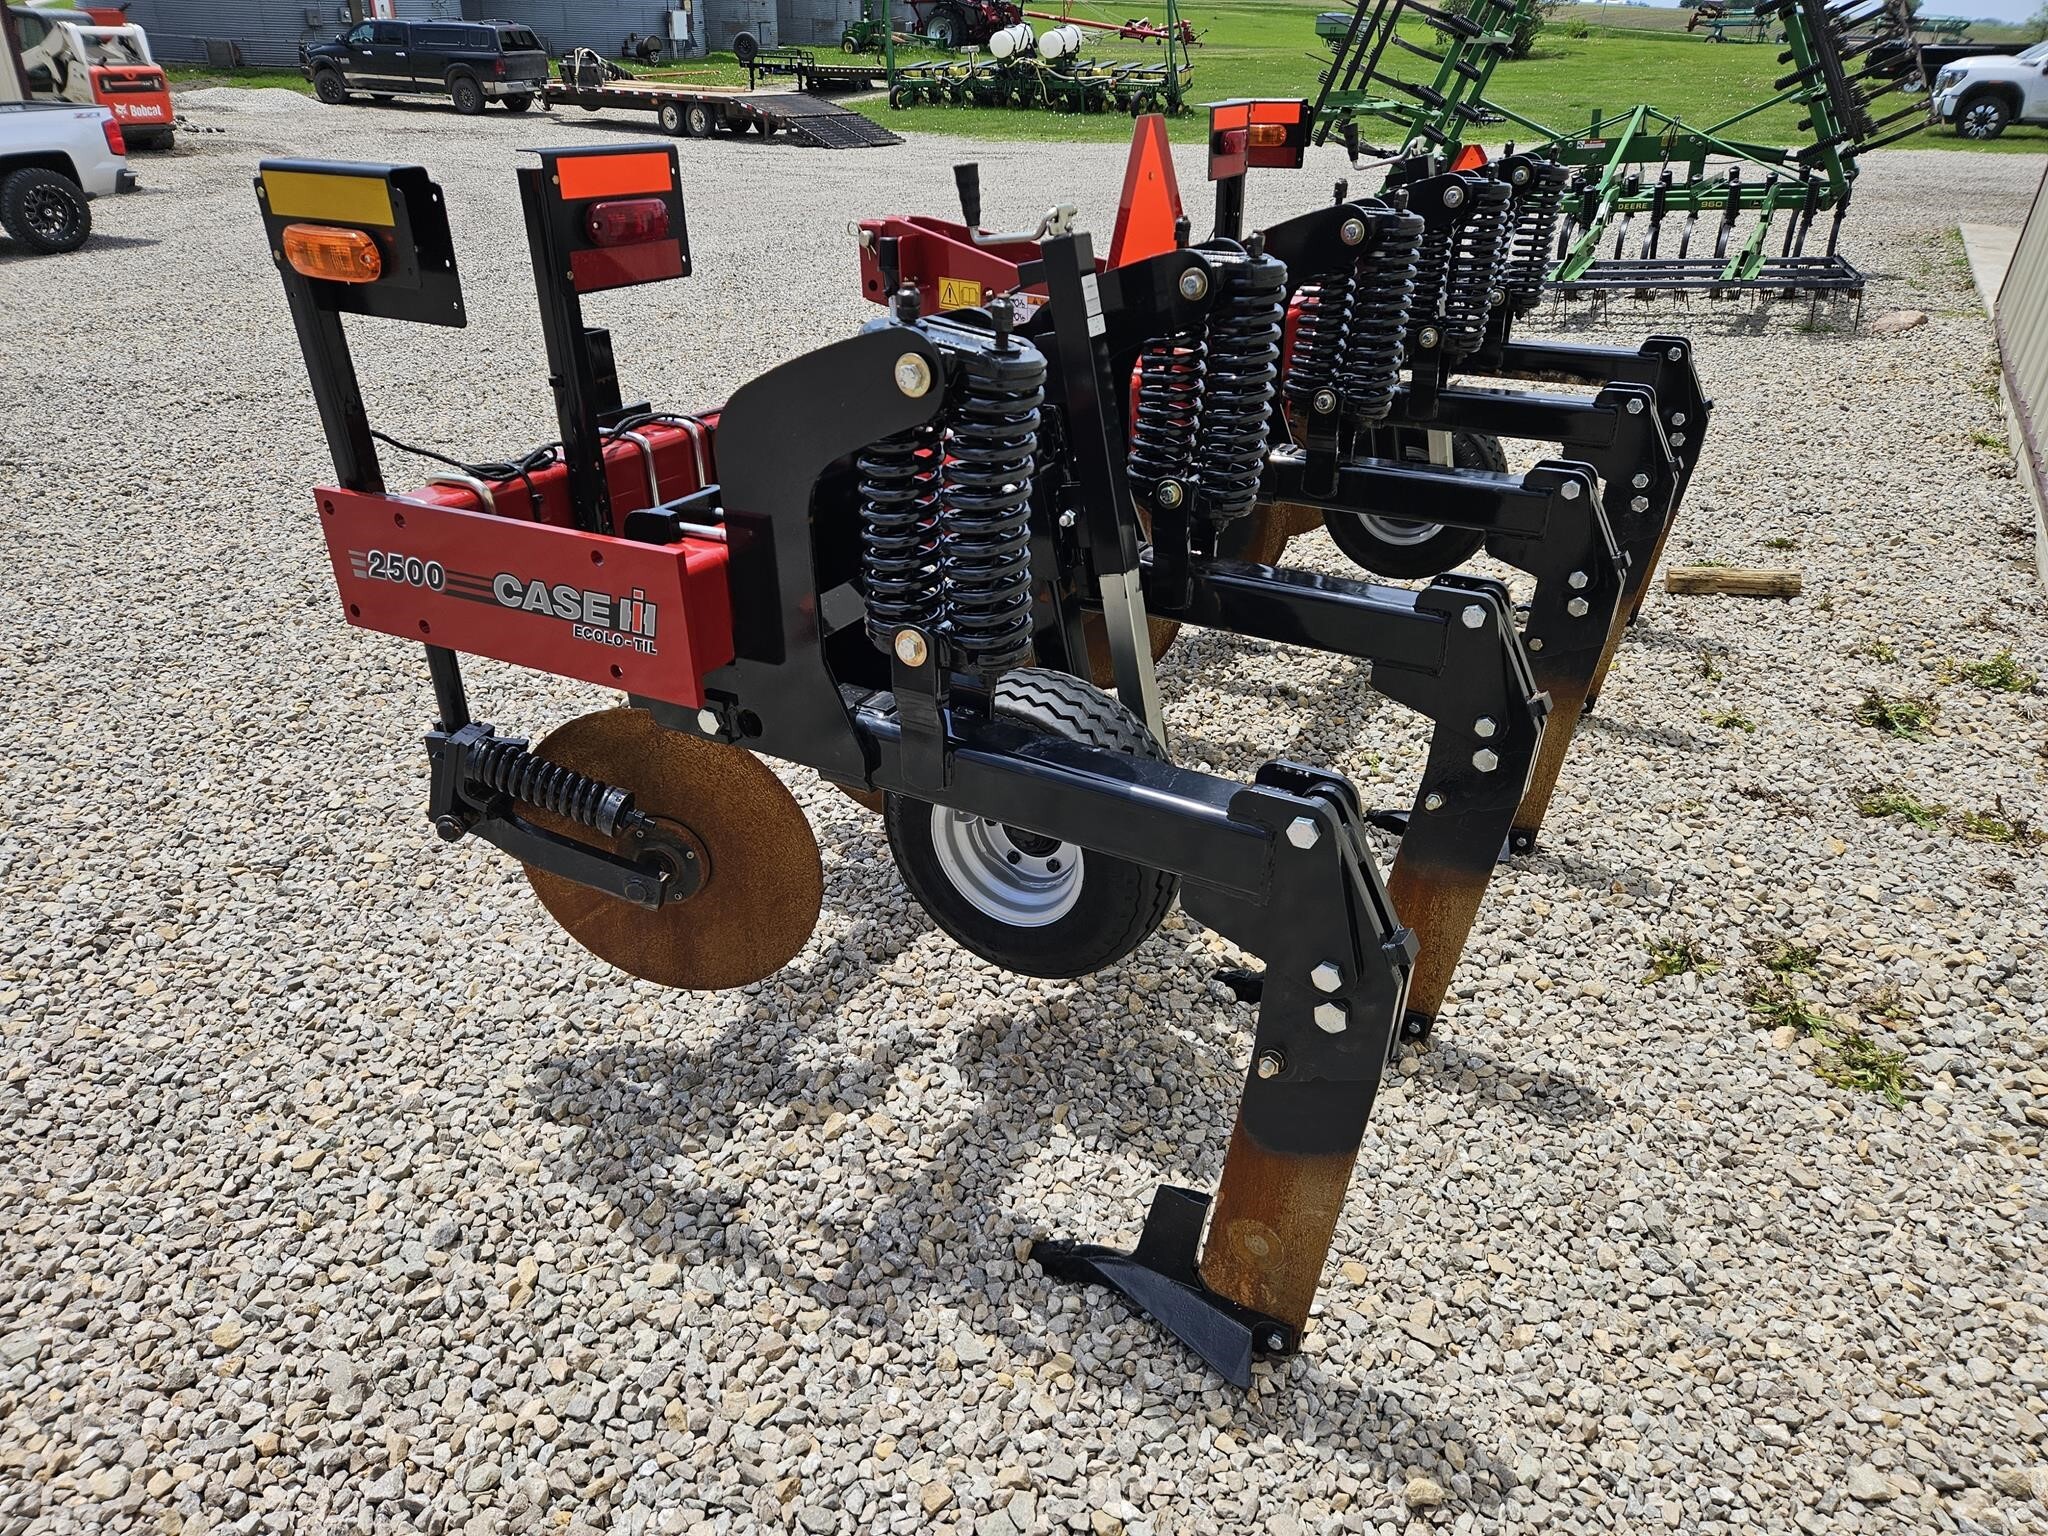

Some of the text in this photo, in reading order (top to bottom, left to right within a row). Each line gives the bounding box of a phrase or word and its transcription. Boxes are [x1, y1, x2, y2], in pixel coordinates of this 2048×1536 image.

[129, 104, 162, 117] Bobcat
[1617, 202, 1648, 210] DEERE
[1701, 200, 1723, 208] 960
[367, 549, 446, 592] 2500
[493, 571, 612, 628] CASE
